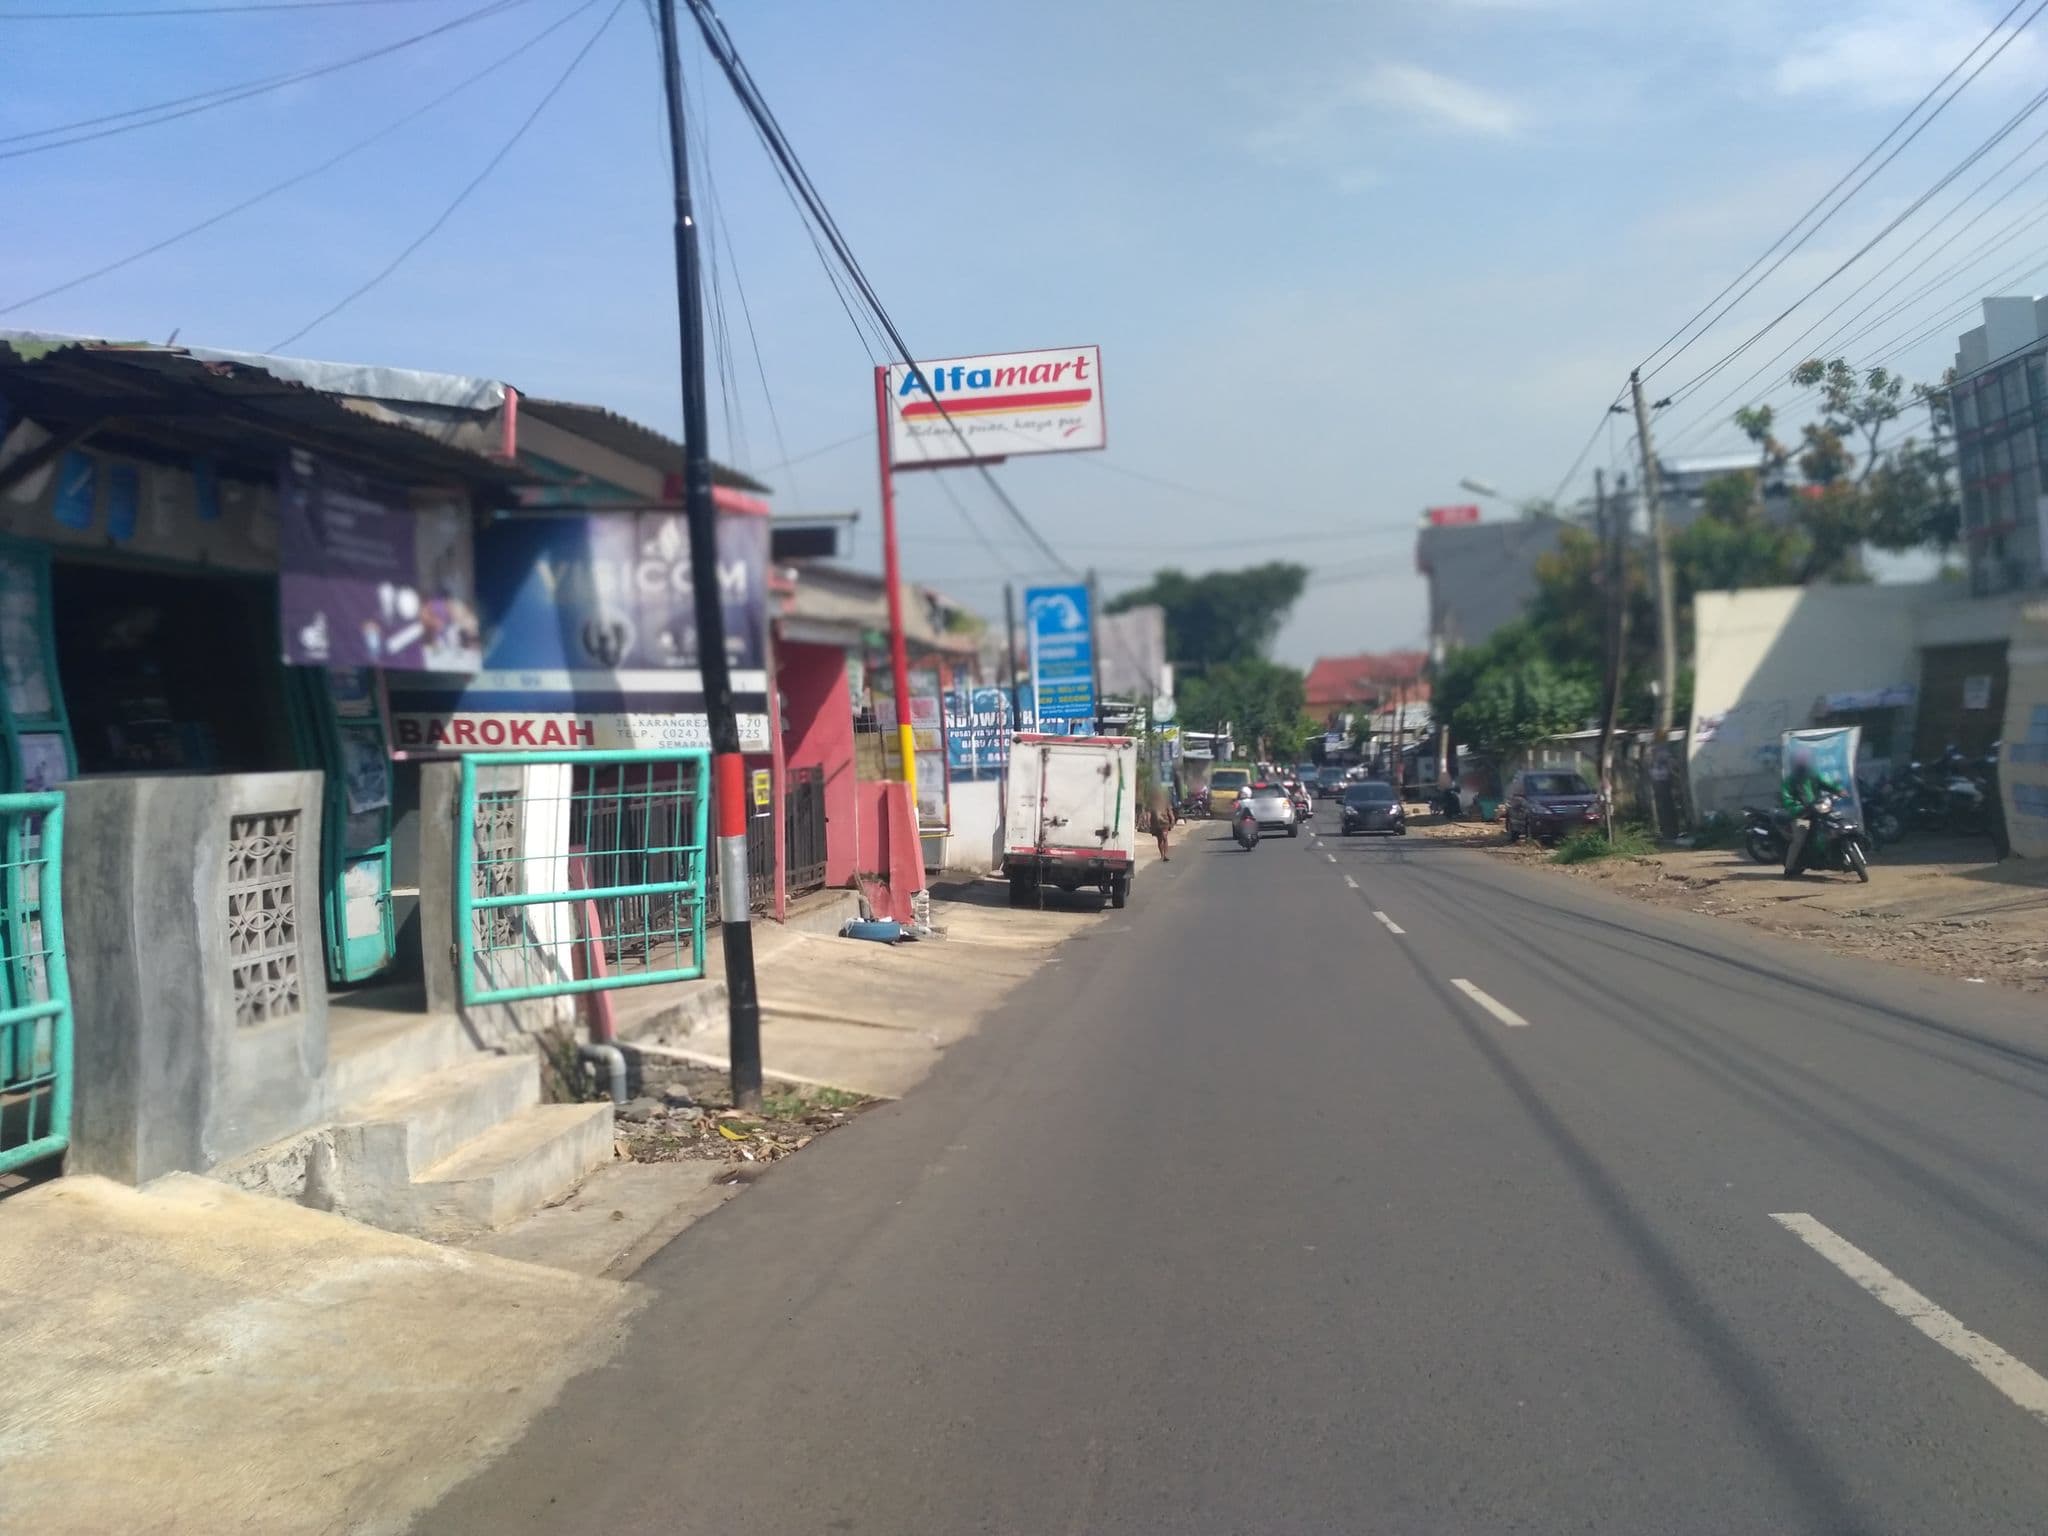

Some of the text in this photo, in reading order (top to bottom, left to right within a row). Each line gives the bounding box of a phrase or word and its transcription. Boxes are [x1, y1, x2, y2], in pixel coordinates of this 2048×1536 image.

[899, 356, 1090, 396] Alfamart
[399, 718, 595, 746] BAROKAH
[662, 729, 700, 740] (024)
[658, 741, 712, 750] SEMARAN
